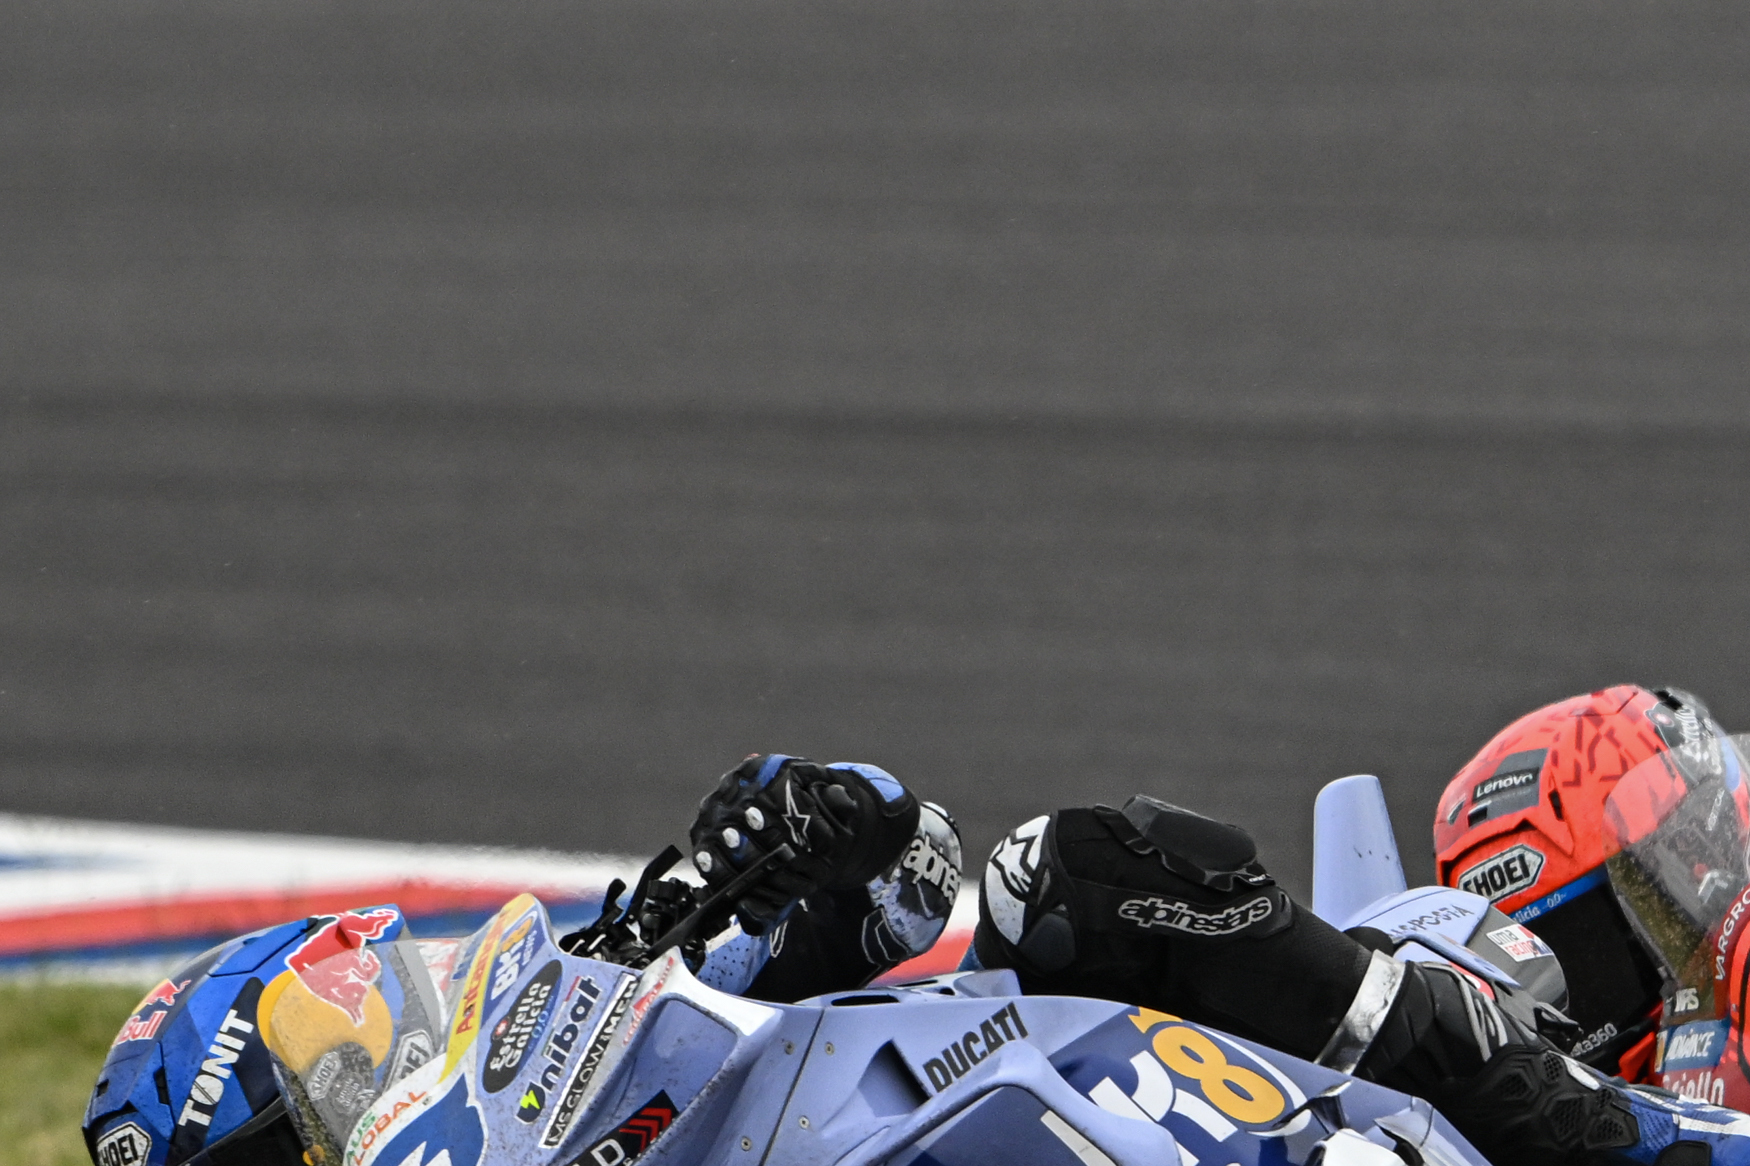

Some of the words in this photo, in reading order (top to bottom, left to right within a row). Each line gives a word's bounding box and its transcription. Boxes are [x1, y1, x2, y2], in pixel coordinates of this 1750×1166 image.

[1118, 896, 1272, 936] alpinestars
[489, 982, 541, 1071] Estrella
[506, 984, 551, 1069] Galicia
[922, 1002, 1029, 1094] DUCATI
